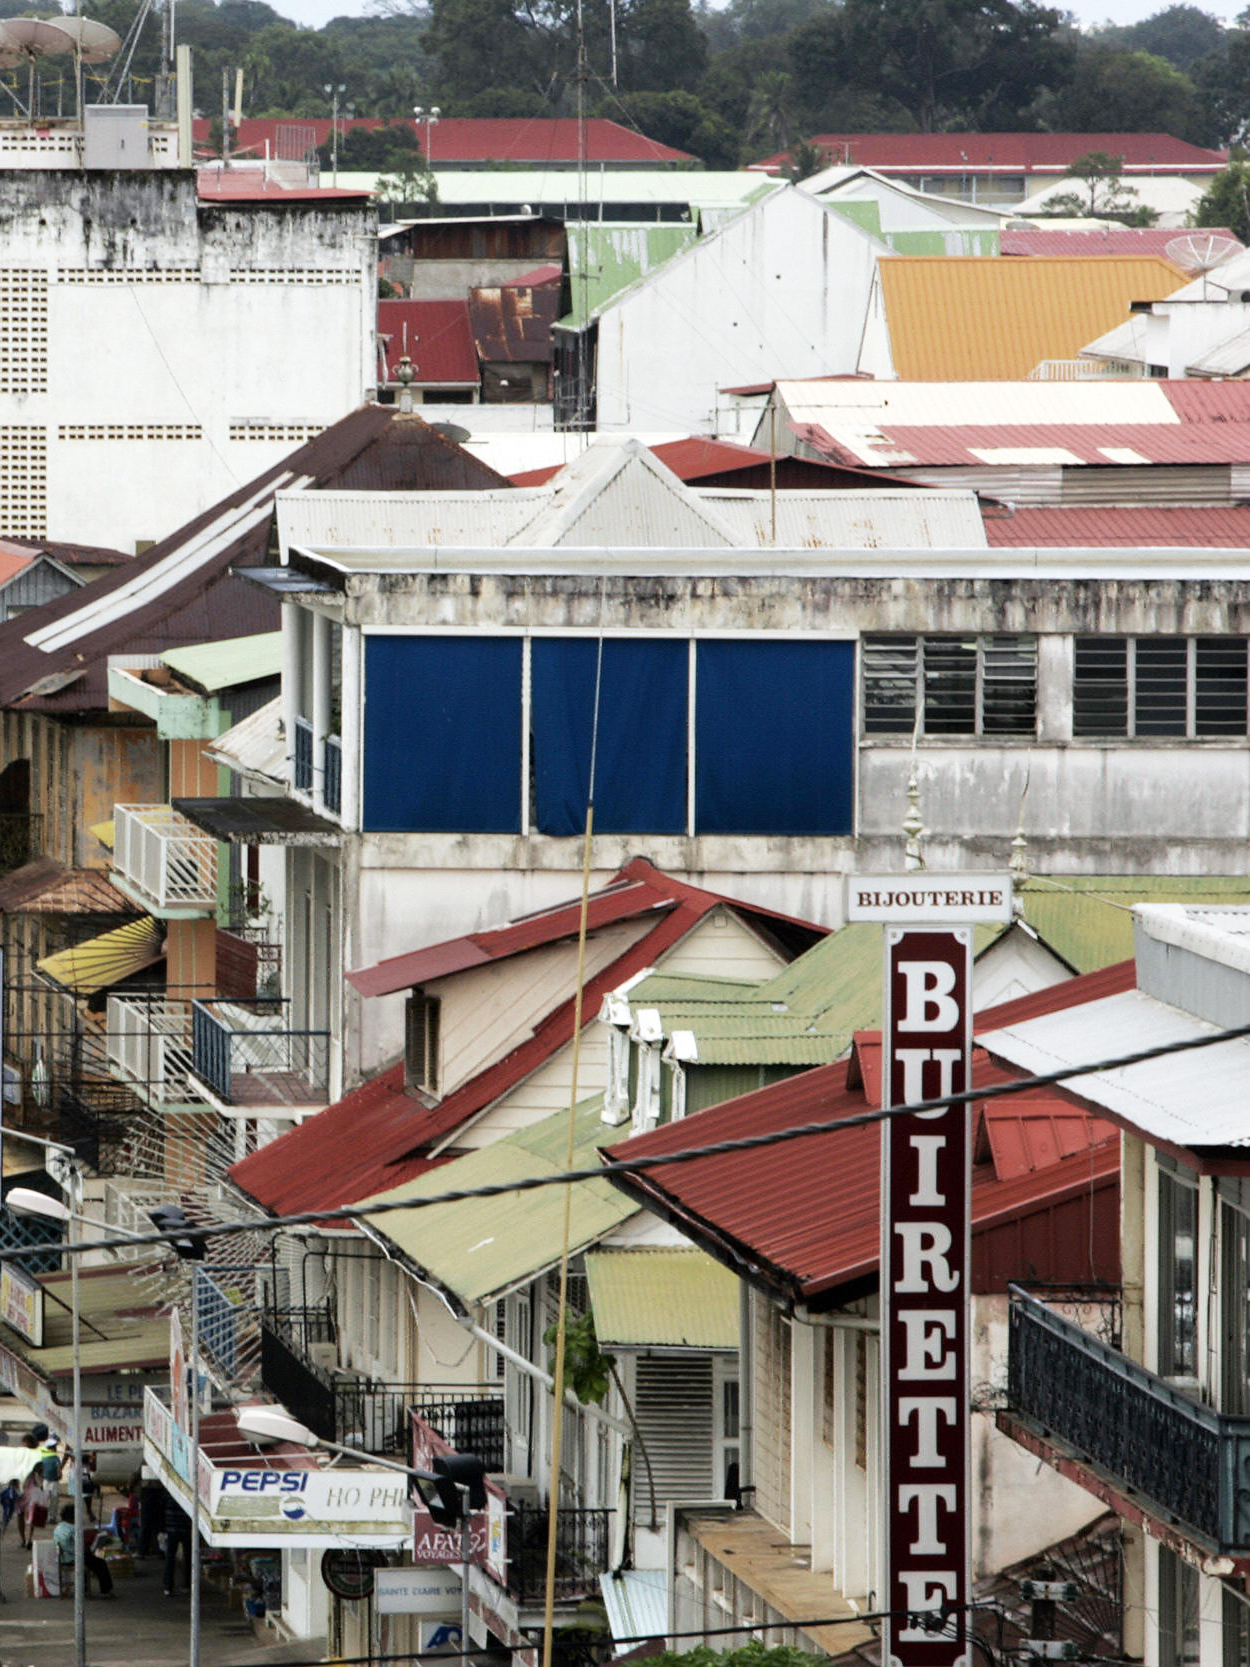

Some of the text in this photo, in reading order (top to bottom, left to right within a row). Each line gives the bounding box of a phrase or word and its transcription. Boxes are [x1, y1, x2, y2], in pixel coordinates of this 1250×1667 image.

[856, 890, 1004, 908] BIJOUTERIE
[894, 960, 960, 1643] BUIRETTE
[220, 1471, 310, 1492] PEPSI
[326, 1486, 361, 1508] HO
